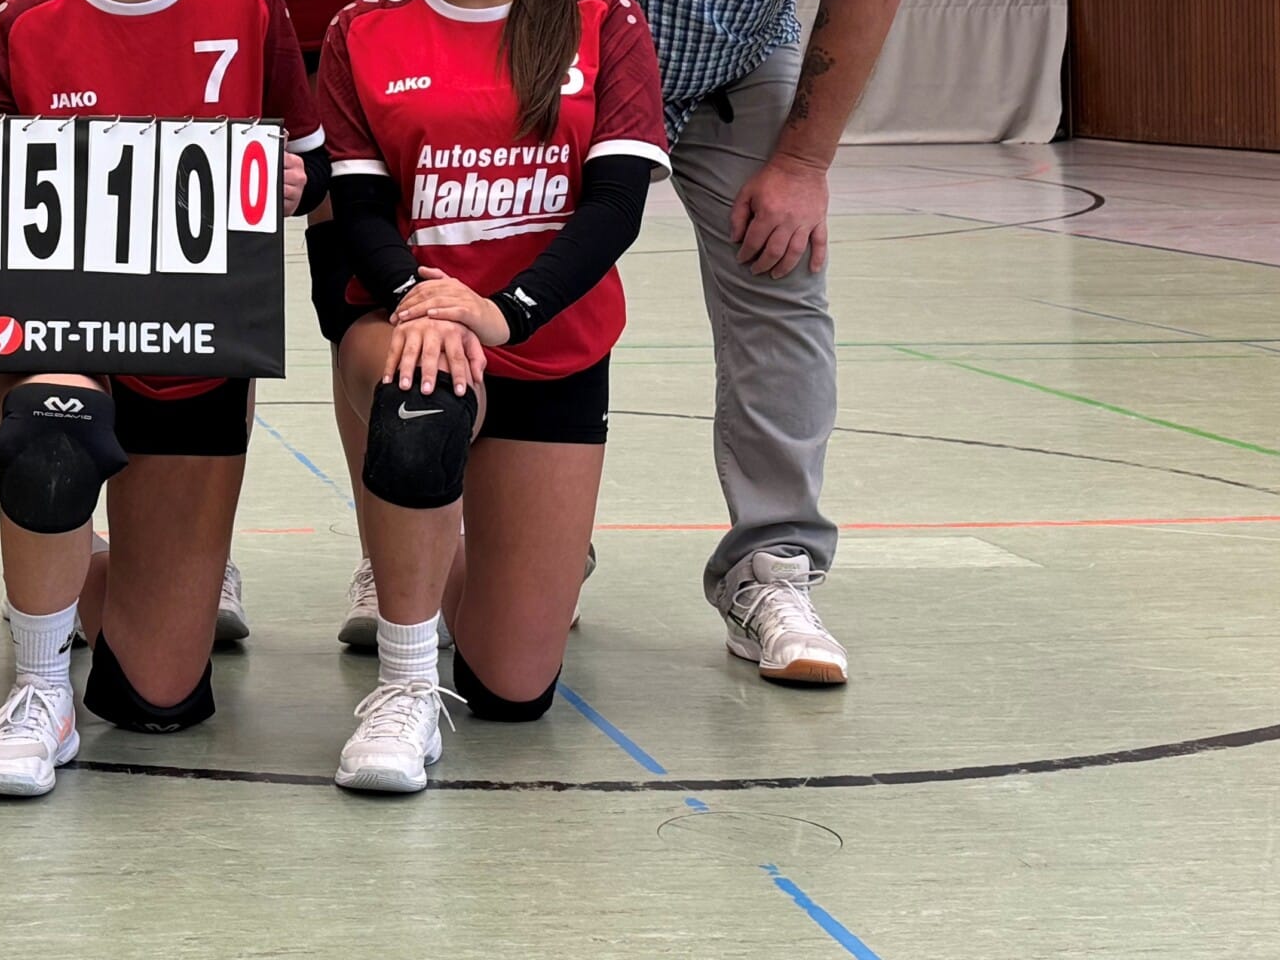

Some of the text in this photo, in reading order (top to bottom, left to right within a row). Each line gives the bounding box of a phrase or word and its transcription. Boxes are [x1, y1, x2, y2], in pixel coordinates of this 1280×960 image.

[193, 39, 239, 104] 7
[385, 74, 432, 95] JAKO
[50, 91, 98, 109] JAKO
[417, 144, 570, 169] Autoservice
[240, 140, 269, 226] 0
[411, 168, 569, 221] Haberle
